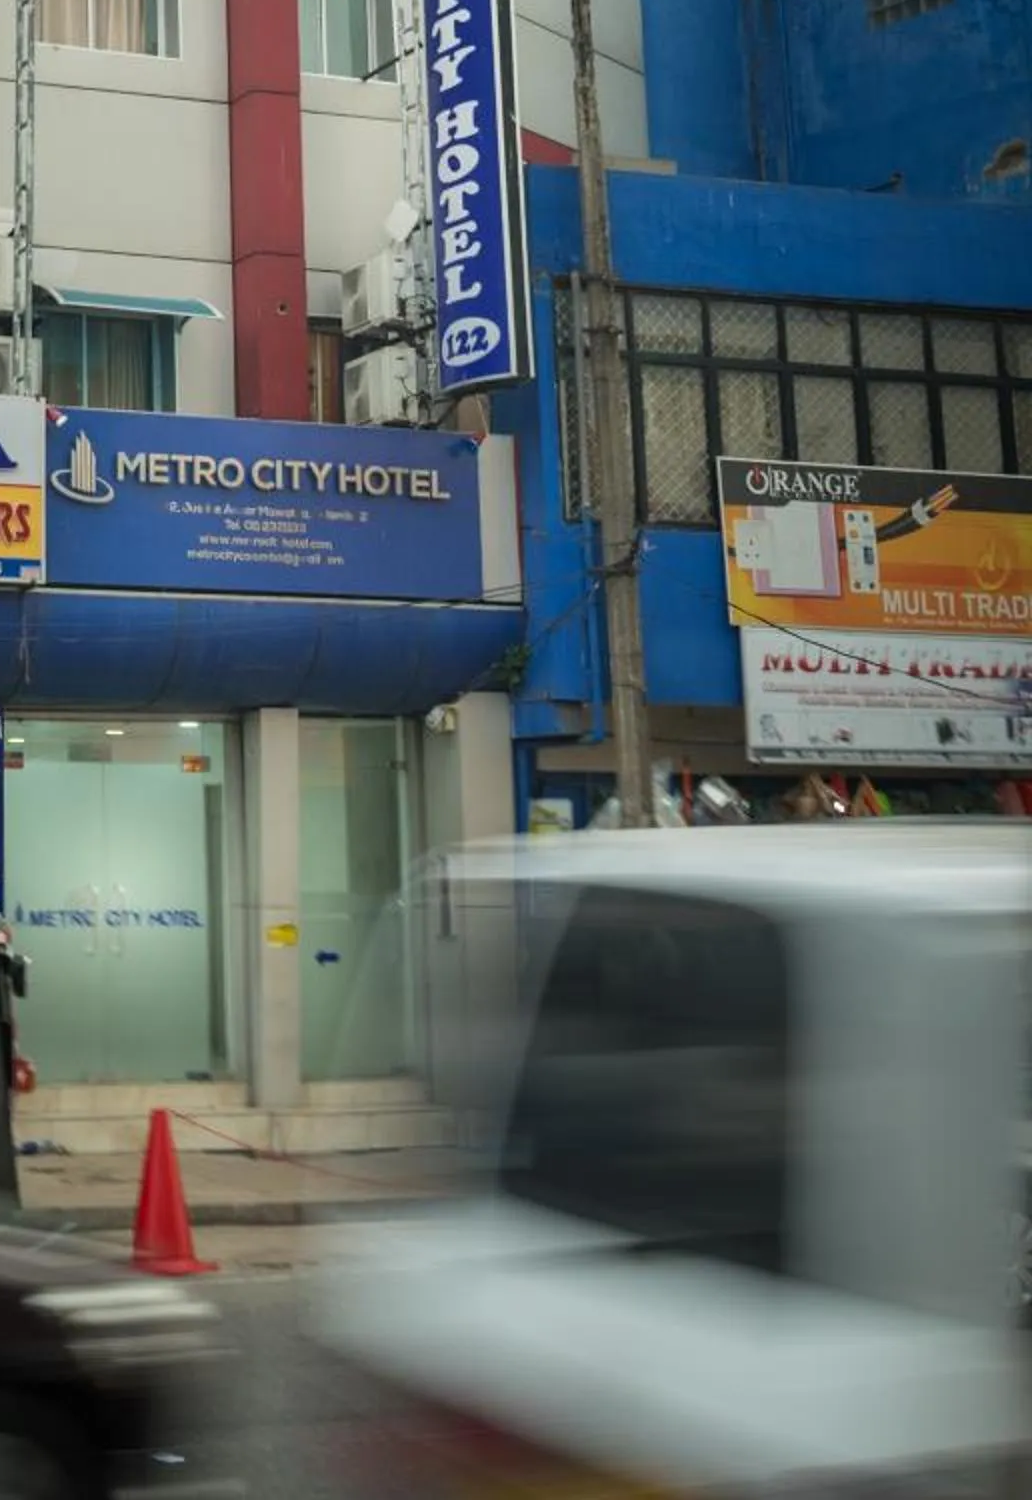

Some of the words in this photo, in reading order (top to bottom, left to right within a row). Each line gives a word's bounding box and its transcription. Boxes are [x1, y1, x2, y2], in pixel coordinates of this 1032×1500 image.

[435, 100, 484, 305] HOTEL
[444, 323, 490, 361] 122
[116, 452, 245, 490] METRO
[251, 458, 333, 493] CITY
[339, 464, 451, 500] HOTEL
[746, 467, 861, 498] ORANGE
[882, 588, 956, 616] MULTI
[961, 592, 1032, 620] TRAD
